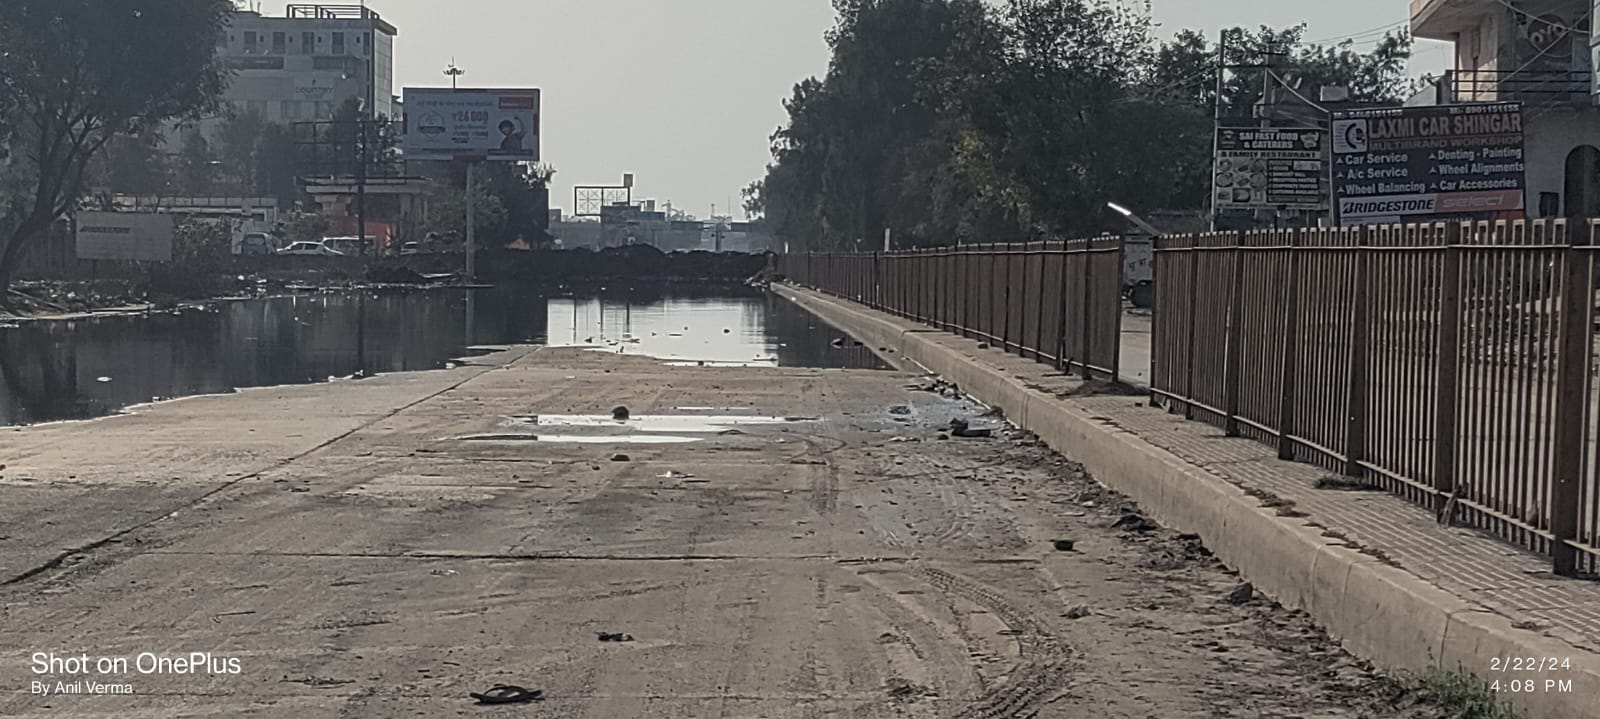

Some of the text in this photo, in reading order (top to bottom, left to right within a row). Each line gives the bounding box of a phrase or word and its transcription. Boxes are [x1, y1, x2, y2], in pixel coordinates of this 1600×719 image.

[1369, 113, 1521, 138] LAXMI CAR SHINGAR
[1239, 132, 1298, 140] SAI FAST FOOD
[1369, 135, 1522, 151] MULTIBRAND WORKSHOP
[1243, 141, 1250, 149] &
[1252, 141, 1293, 149] CATERERS
[1345, 153, 1408, 165] Car Service
[1438, 149, 1475, 161] Denting
[1482, 147, 1522, 159] Painting
[1367, 167, 1408, 178] Service
[1439, 162, 1524, 176] Wheel Alignments
[1345, 181, 1426, 195] Wheel Balancing
[1439, 178, 1518, 191] Car Accessories
[1342, 199, 1435, 215] BRIDGESTONE
